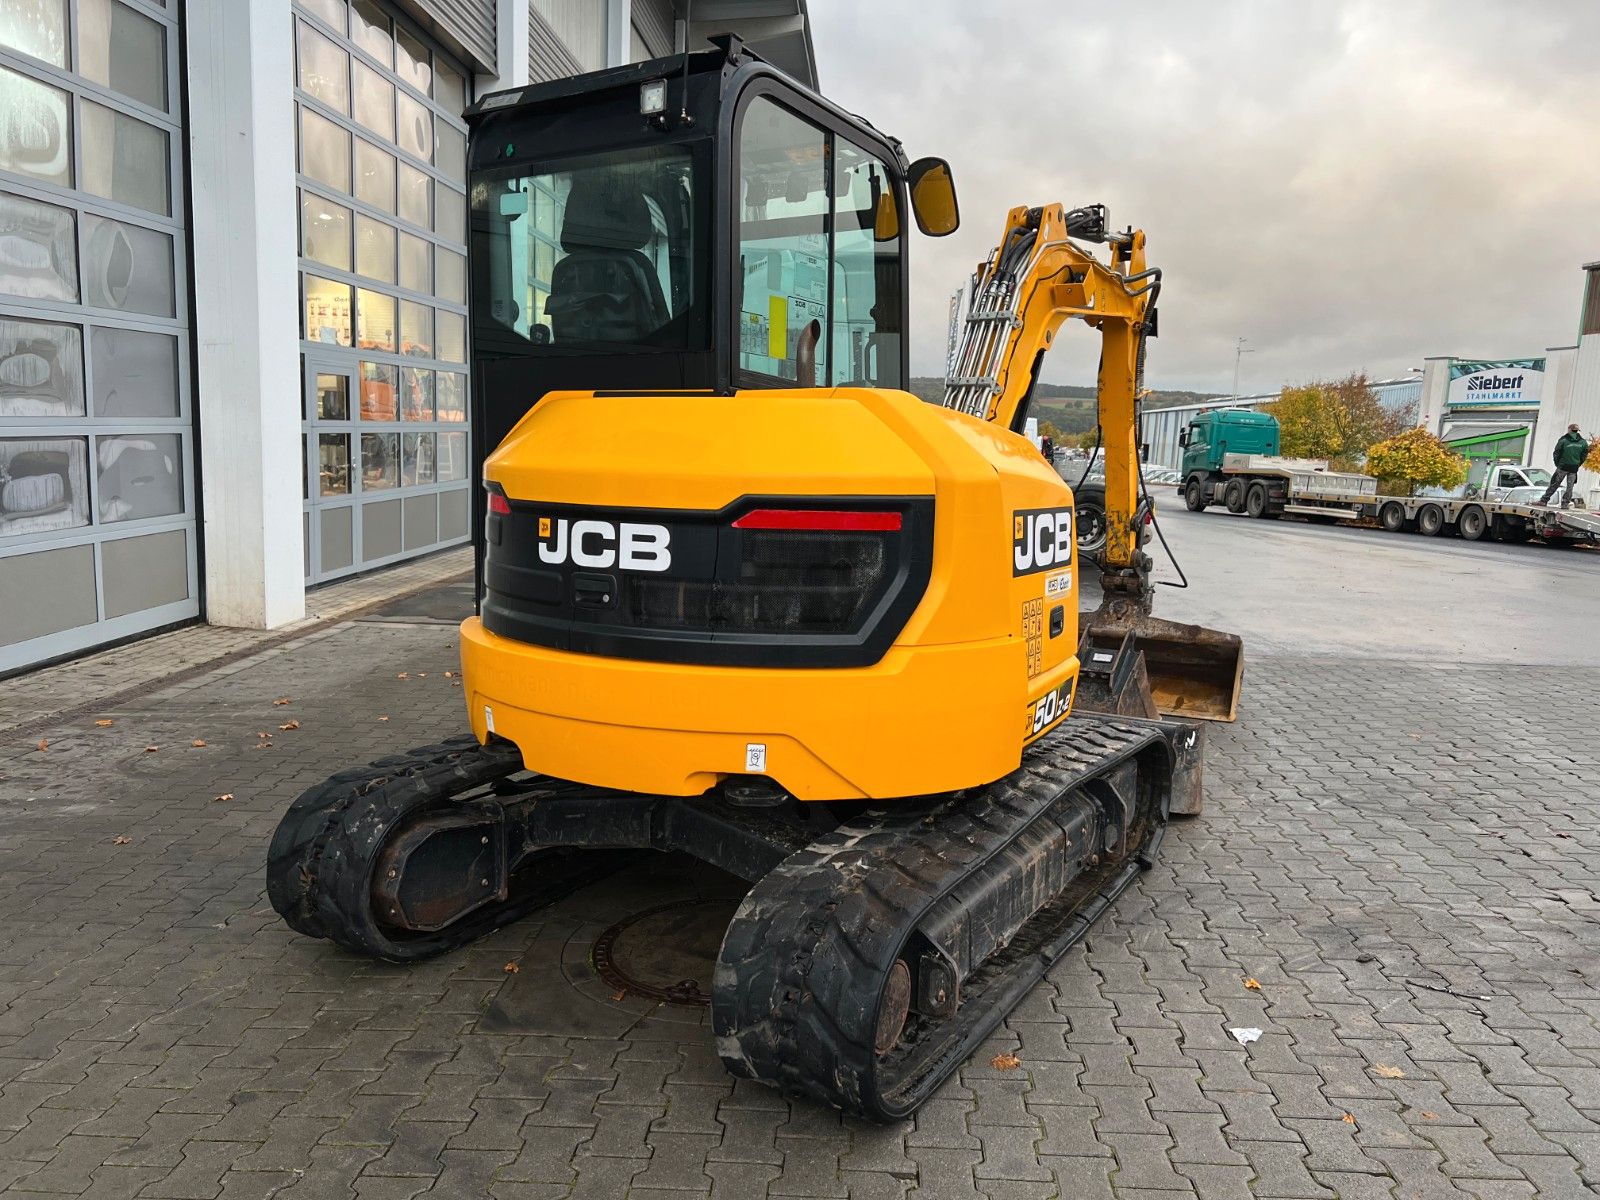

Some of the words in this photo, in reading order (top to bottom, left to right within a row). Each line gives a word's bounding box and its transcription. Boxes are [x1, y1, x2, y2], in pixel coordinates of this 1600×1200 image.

[1466, 391, 1522, 400] STAHLMARKT
[1468, 374, 1523, 390] Siebert
[538, 518, 672, 572] JCB
[1014, 512, 1072, 571] JCB
[1033, 690, 1058, 733] 50
